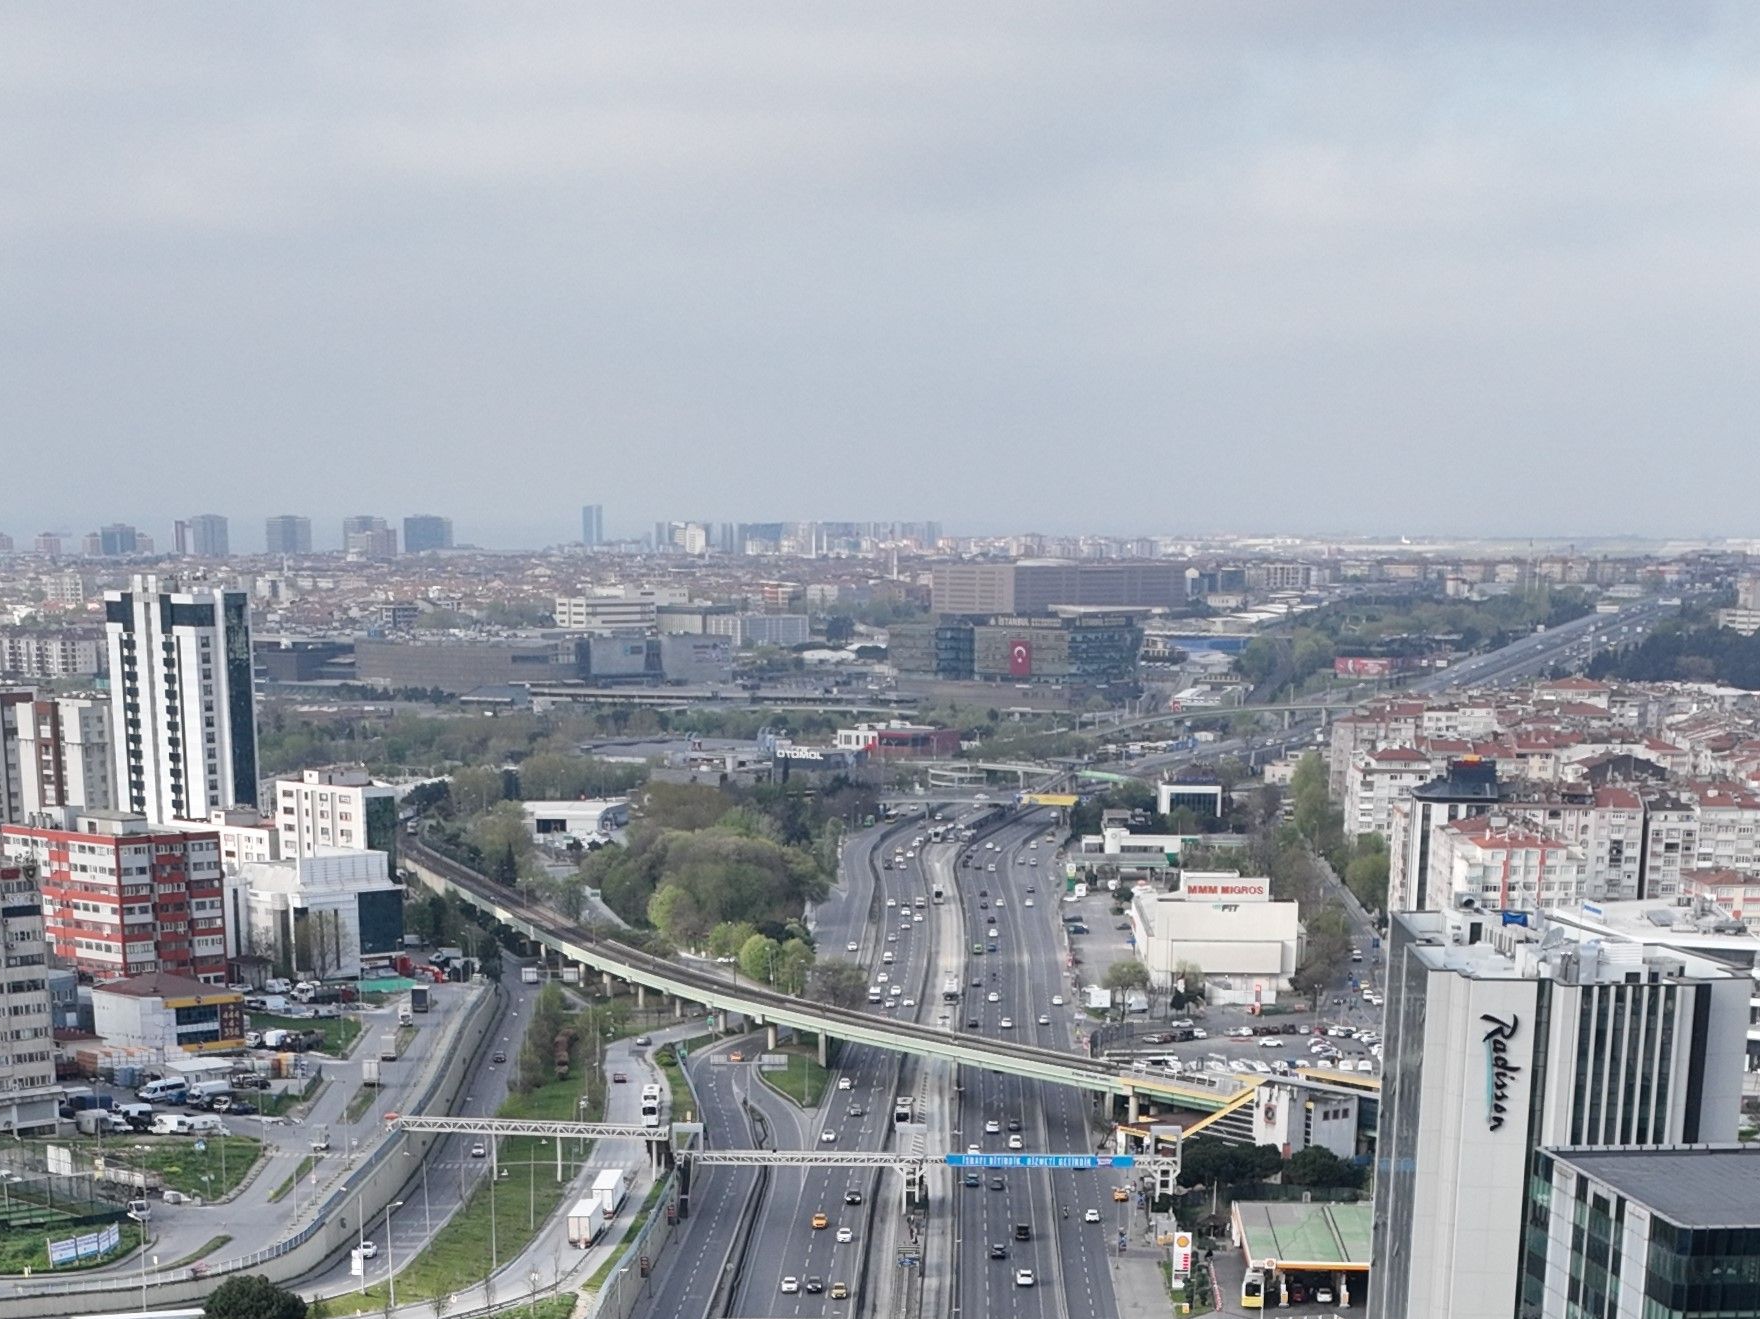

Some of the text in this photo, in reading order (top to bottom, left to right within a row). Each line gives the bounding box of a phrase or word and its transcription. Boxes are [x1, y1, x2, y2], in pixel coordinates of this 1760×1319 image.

[776, 749, 824, 760] OTOMOL
[1187, 885, 1264, 895] MMM MIGROS
[1480, 1013, 1521, 1132] Radisson
